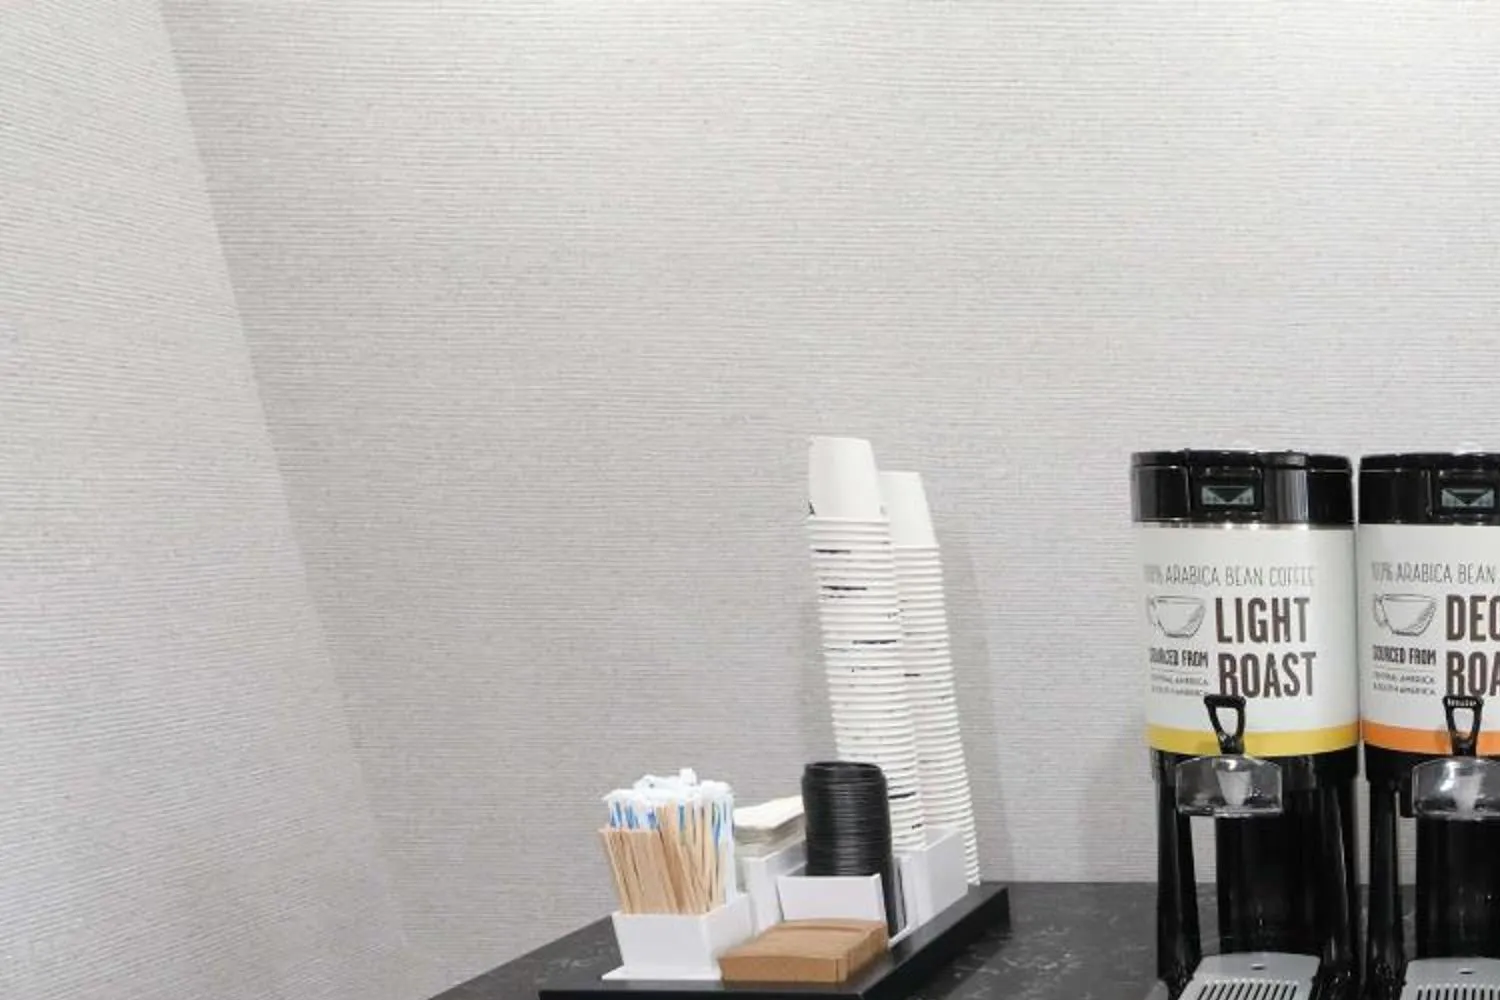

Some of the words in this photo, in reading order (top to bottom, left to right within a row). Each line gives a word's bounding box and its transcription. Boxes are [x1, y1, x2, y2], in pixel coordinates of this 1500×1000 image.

[1165, 564, 1221, 586] ARABICA
[1225, 565, 1263, 586] BEAN
[1269, 565, 1315, 587] COFFEE
[1396, 562, 1452, 583] ARABICA
[1458, 563, 1497, 584] BEAN
[1215, 597, 1310, 643] LIGHT
[1181, 650, 1208, 668] FROM
[1409, 648, 1437, 666] FROM
[1218, 651, 1317, 698] ROAST
